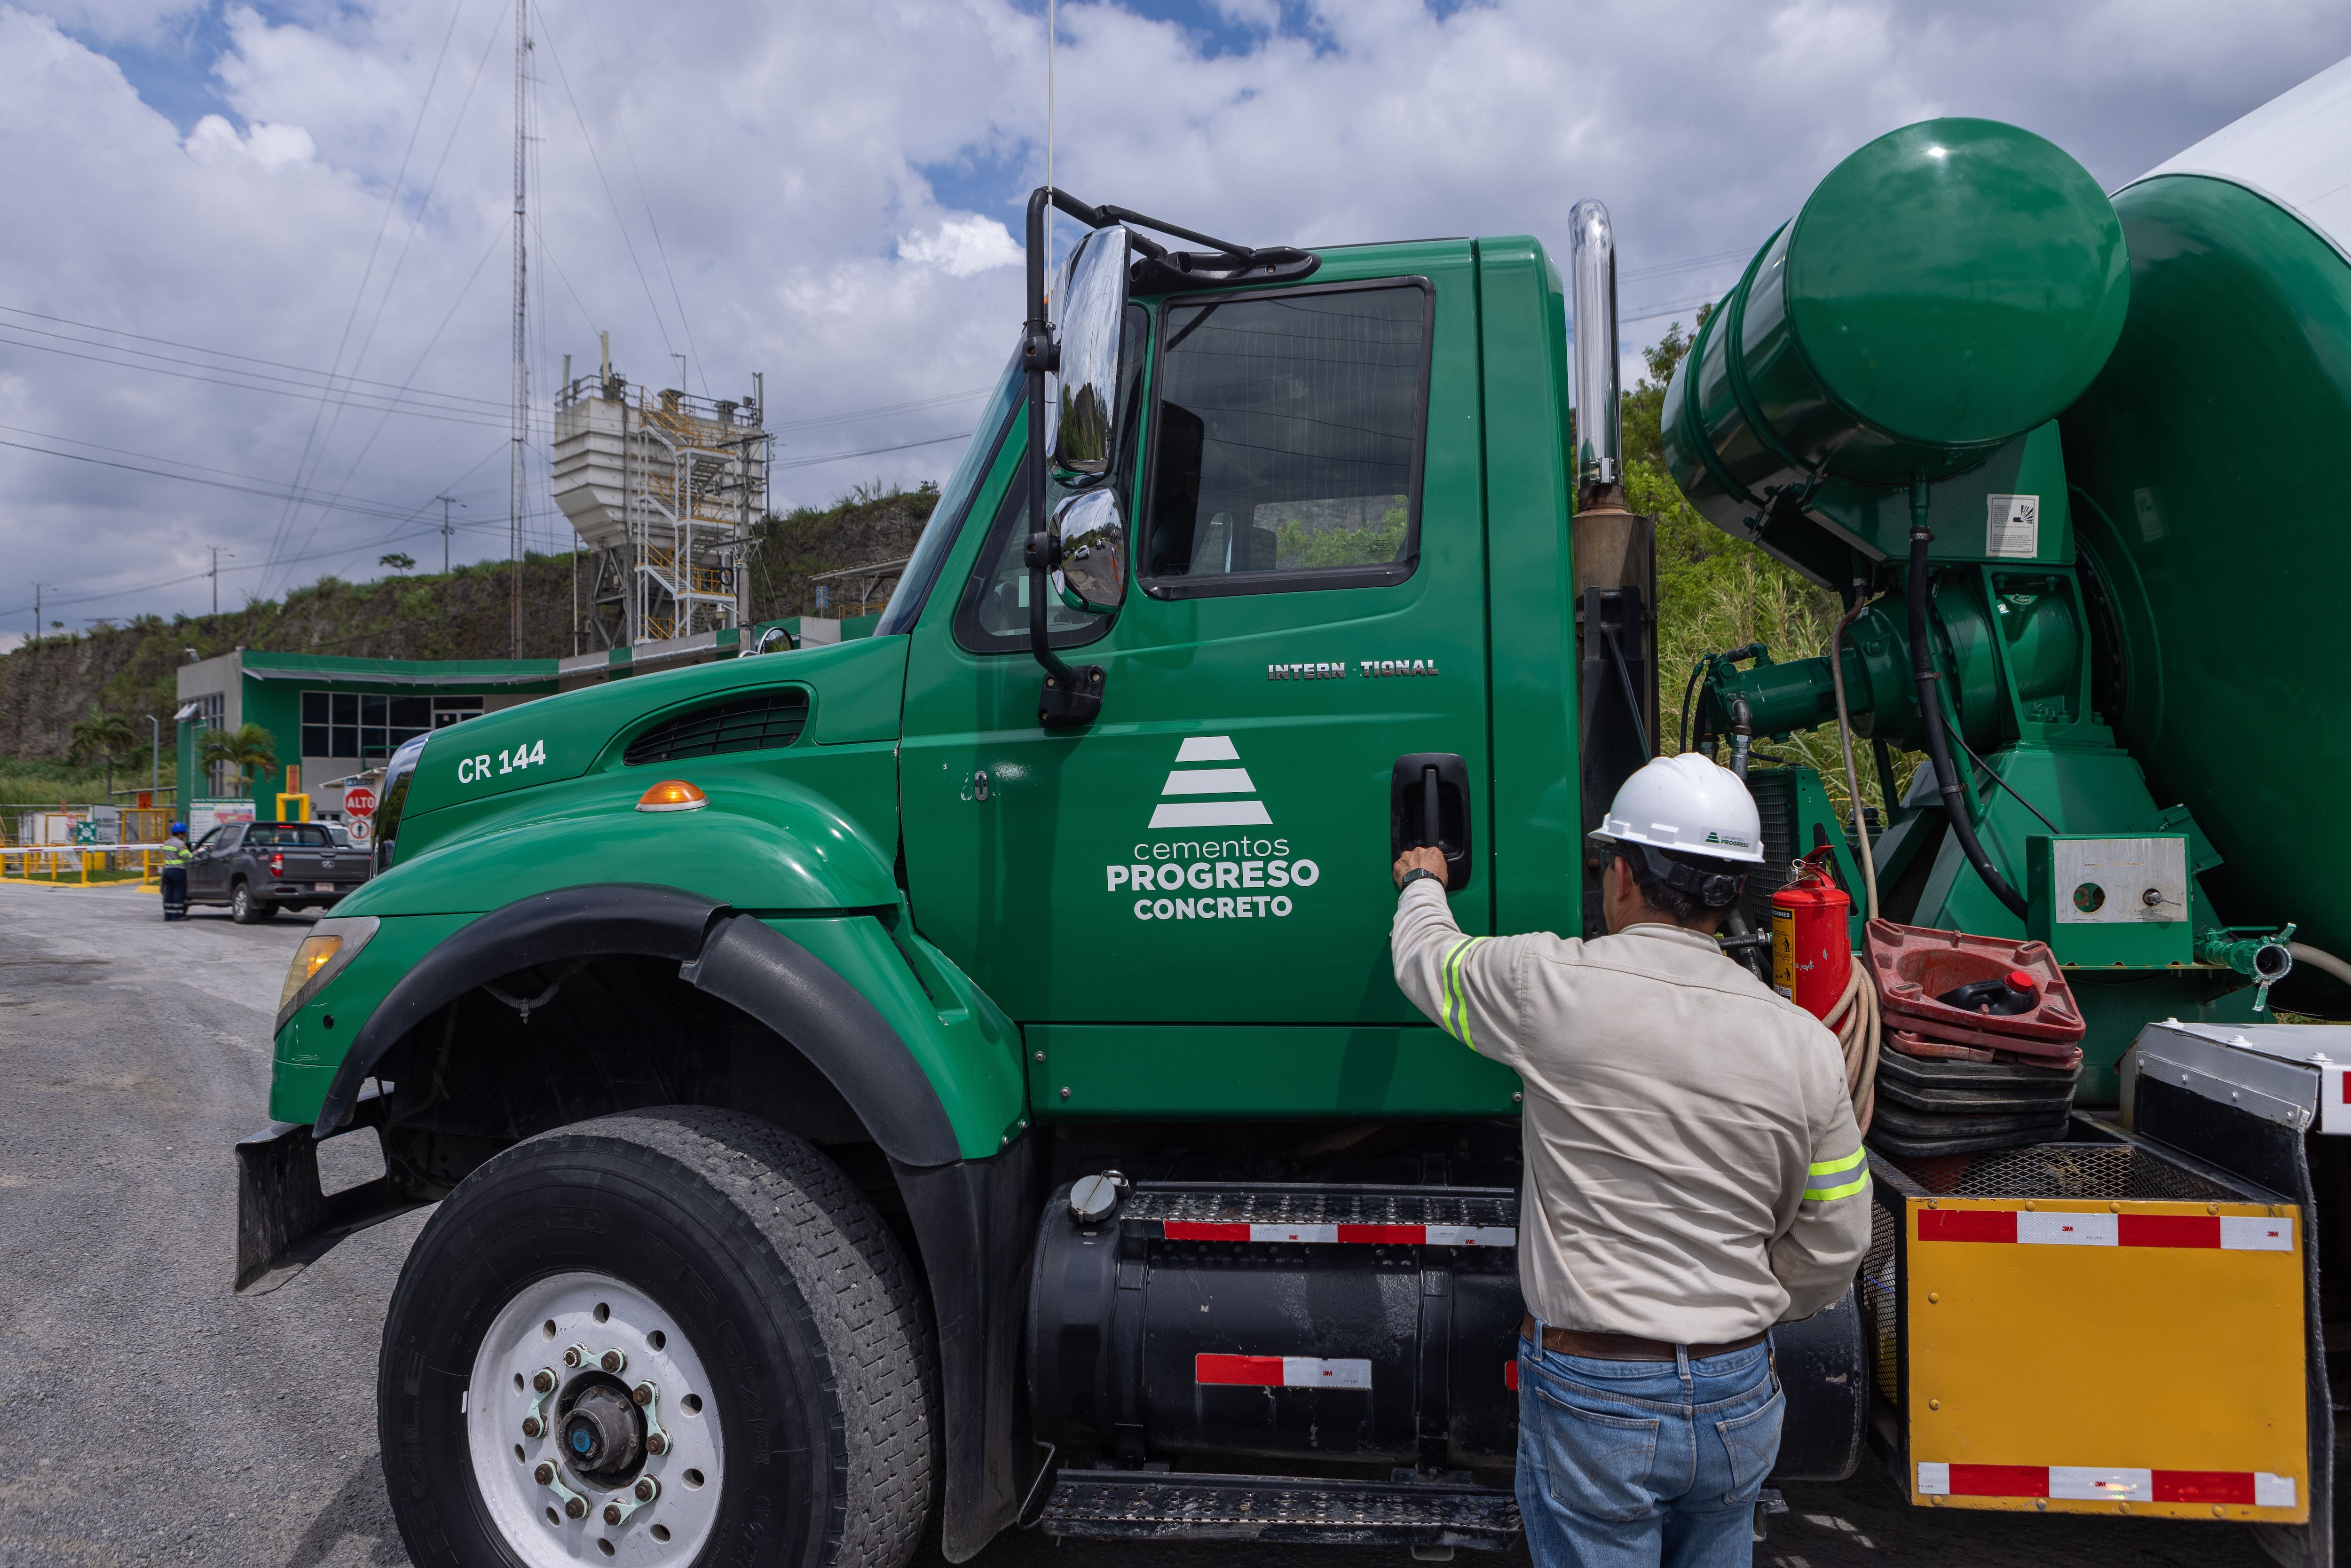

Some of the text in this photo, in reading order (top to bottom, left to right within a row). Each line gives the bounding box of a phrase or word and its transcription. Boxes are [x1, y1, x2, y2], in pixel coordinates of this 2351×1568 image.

[458, 740, 546, 784] CR 144
[347, 796, 374, 809] ALTO
[1134, 836, 1290, 860] cementos
[1720, 839, 1749, 848] PROGRESO
[1106, 859, 1319, 891] PROGRESO
[1134, 895, 1293, 920] CONCRETO
